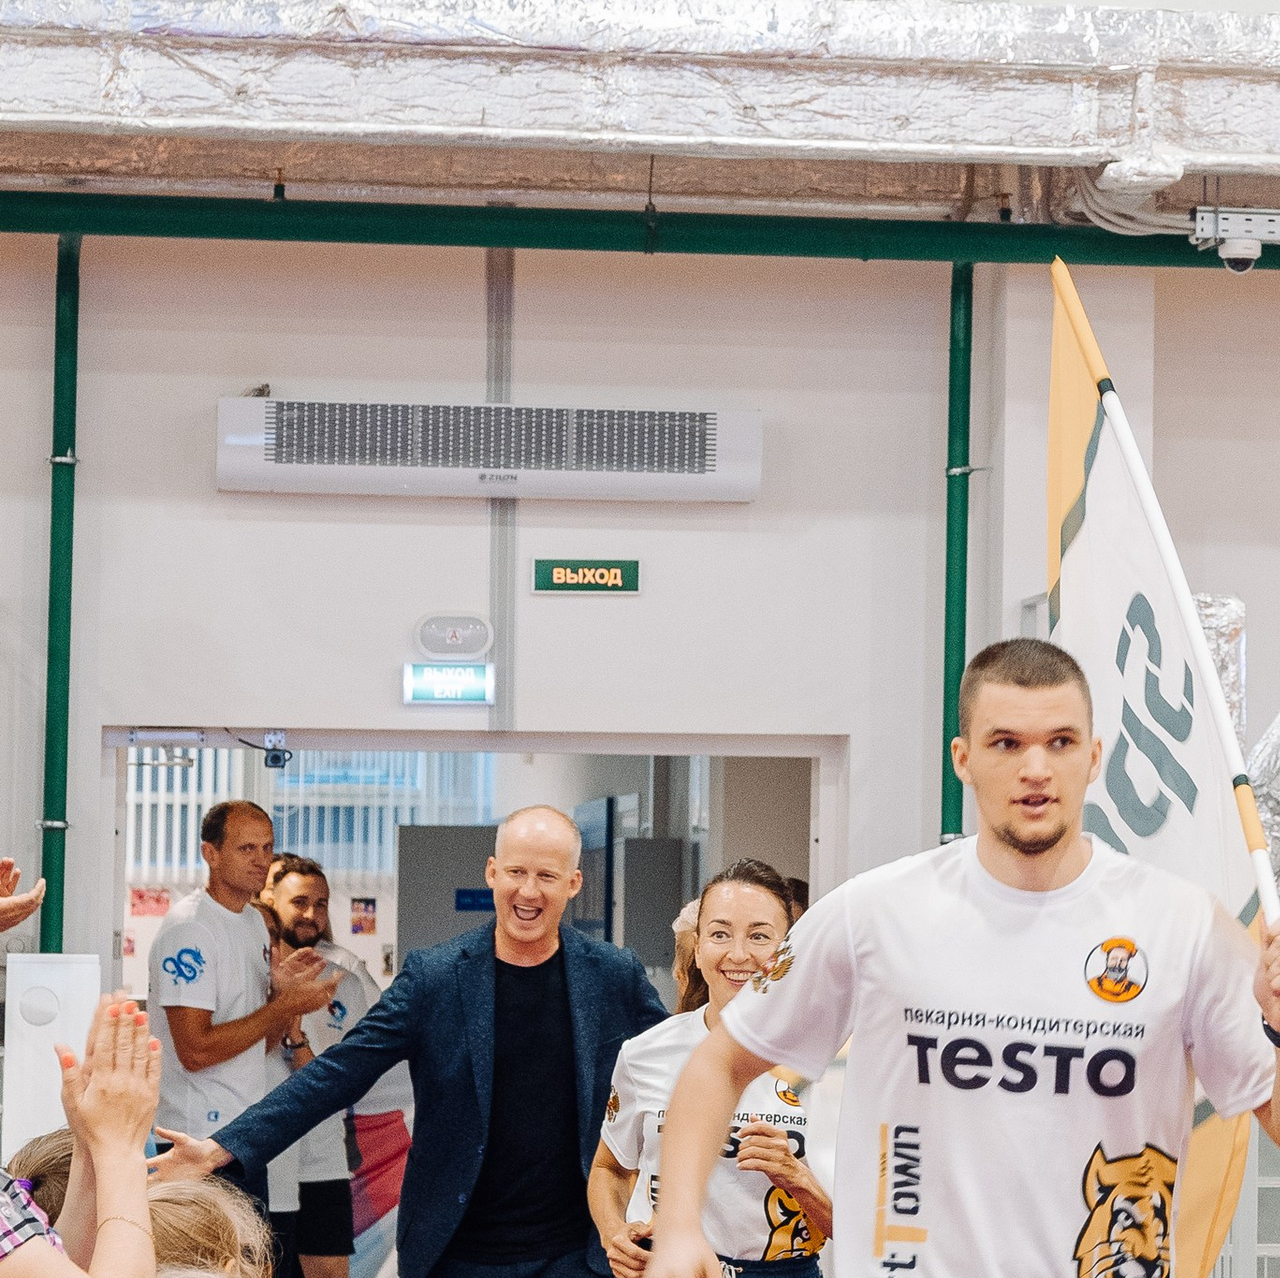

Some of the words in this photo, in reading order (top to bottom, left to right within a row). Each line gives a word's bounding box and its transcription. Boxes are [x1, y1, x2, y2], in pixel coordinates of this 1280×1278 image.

[552, 567, 623, 587] ВЫХОД
[423, 667, 475, 683] ВЫХОД
[433, 684, 464, 699] EXIT
[904, 1007, 1146, 1039] пекарня-кондитерская
